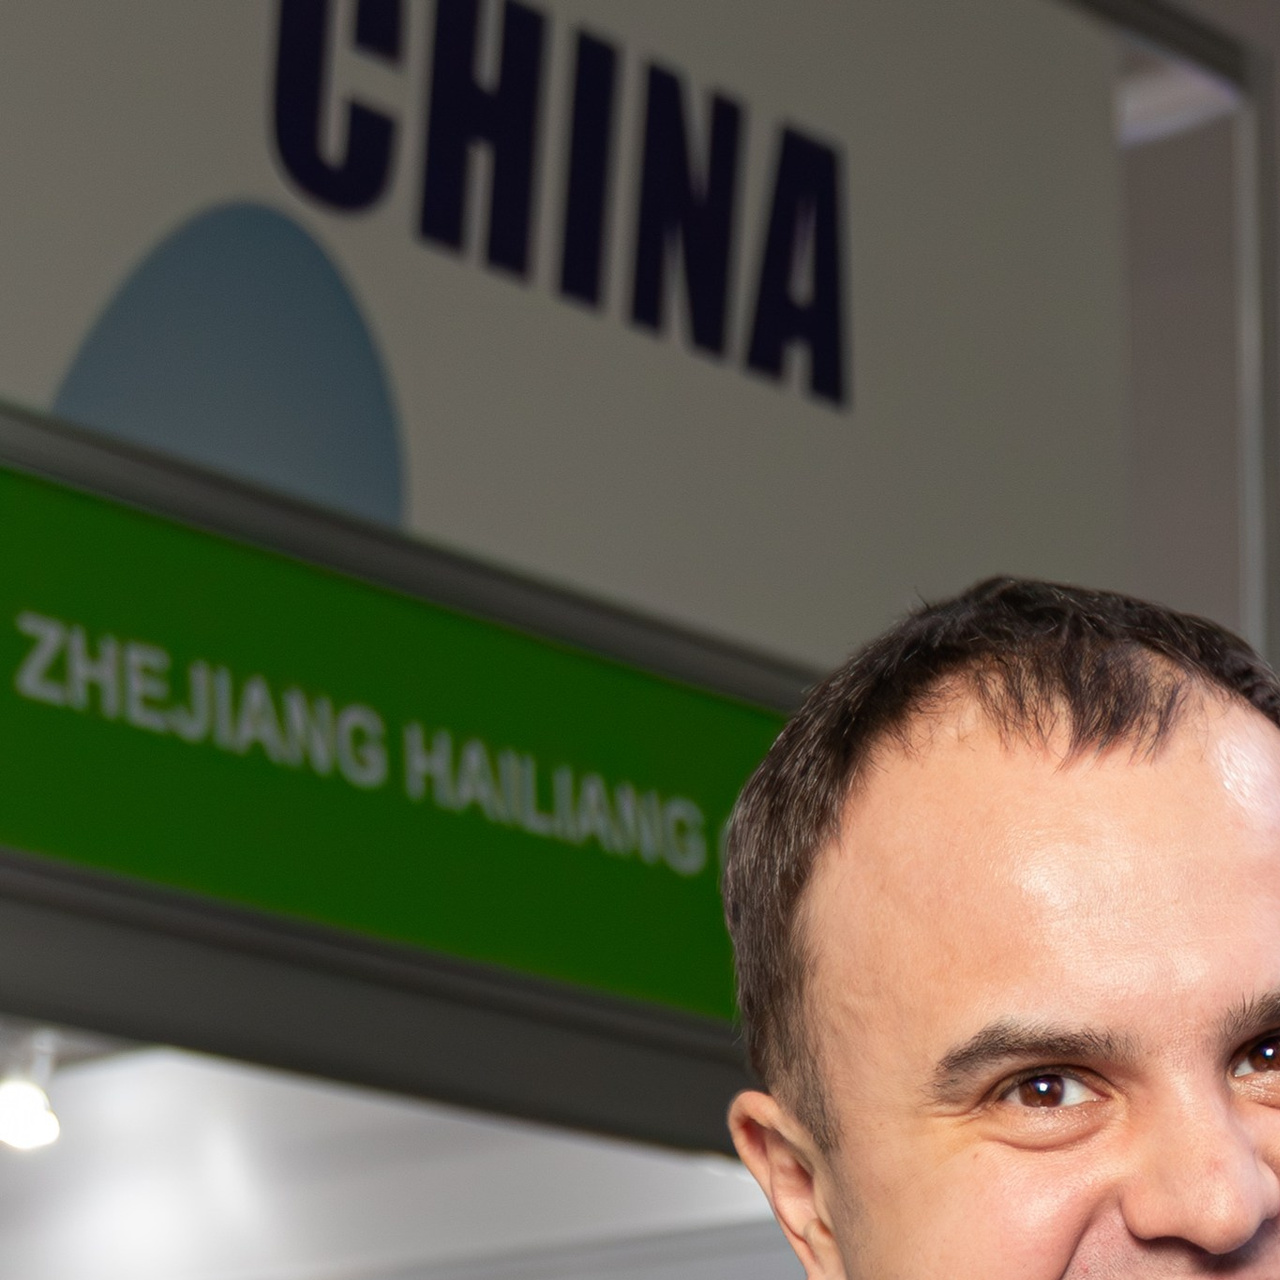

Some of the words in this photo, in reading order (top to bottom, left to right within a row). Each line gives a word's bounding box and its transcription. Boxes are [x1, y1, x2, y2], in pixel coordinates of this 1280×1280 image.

[269, 0, 852, 415] CHINA
[13, 610, 391, 791] ZHEJIANG
[402, 717, 709, 879] HAILIANG
